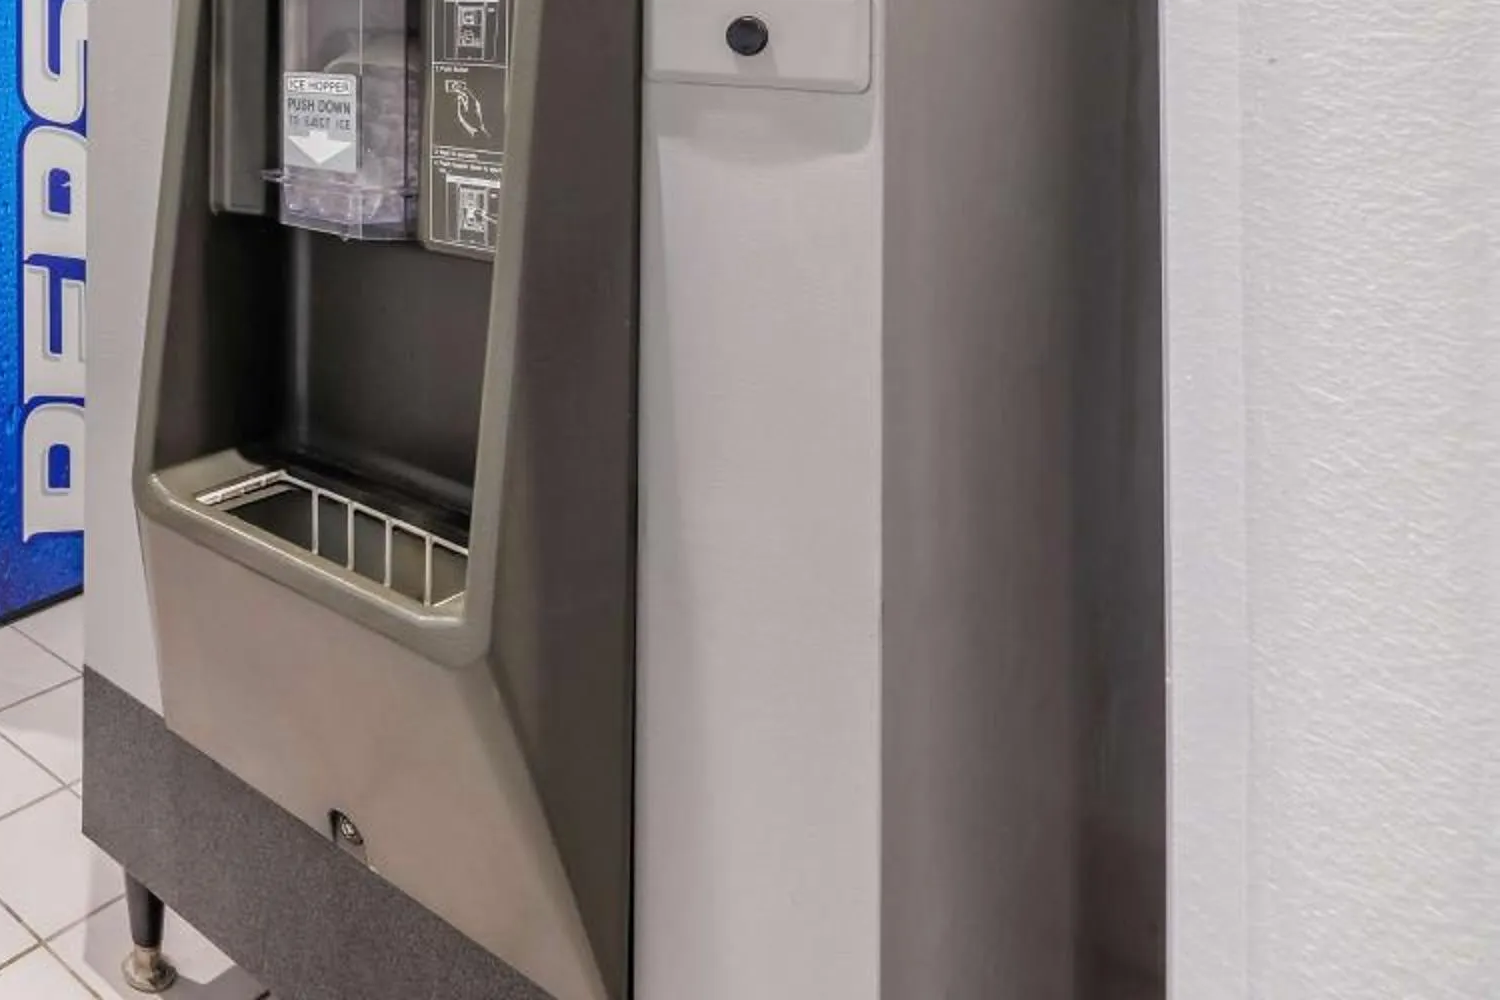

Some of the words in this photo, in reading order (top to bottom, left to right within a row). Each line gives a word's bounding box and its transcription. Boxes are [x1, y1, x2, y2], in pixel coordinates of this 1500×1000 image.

[288, 78, 306, 90] ICE
[287, 97, 315, 112] PUSH
[317, 99, 351, 115] DOWN
[336, 118, 351, 131] ICE
